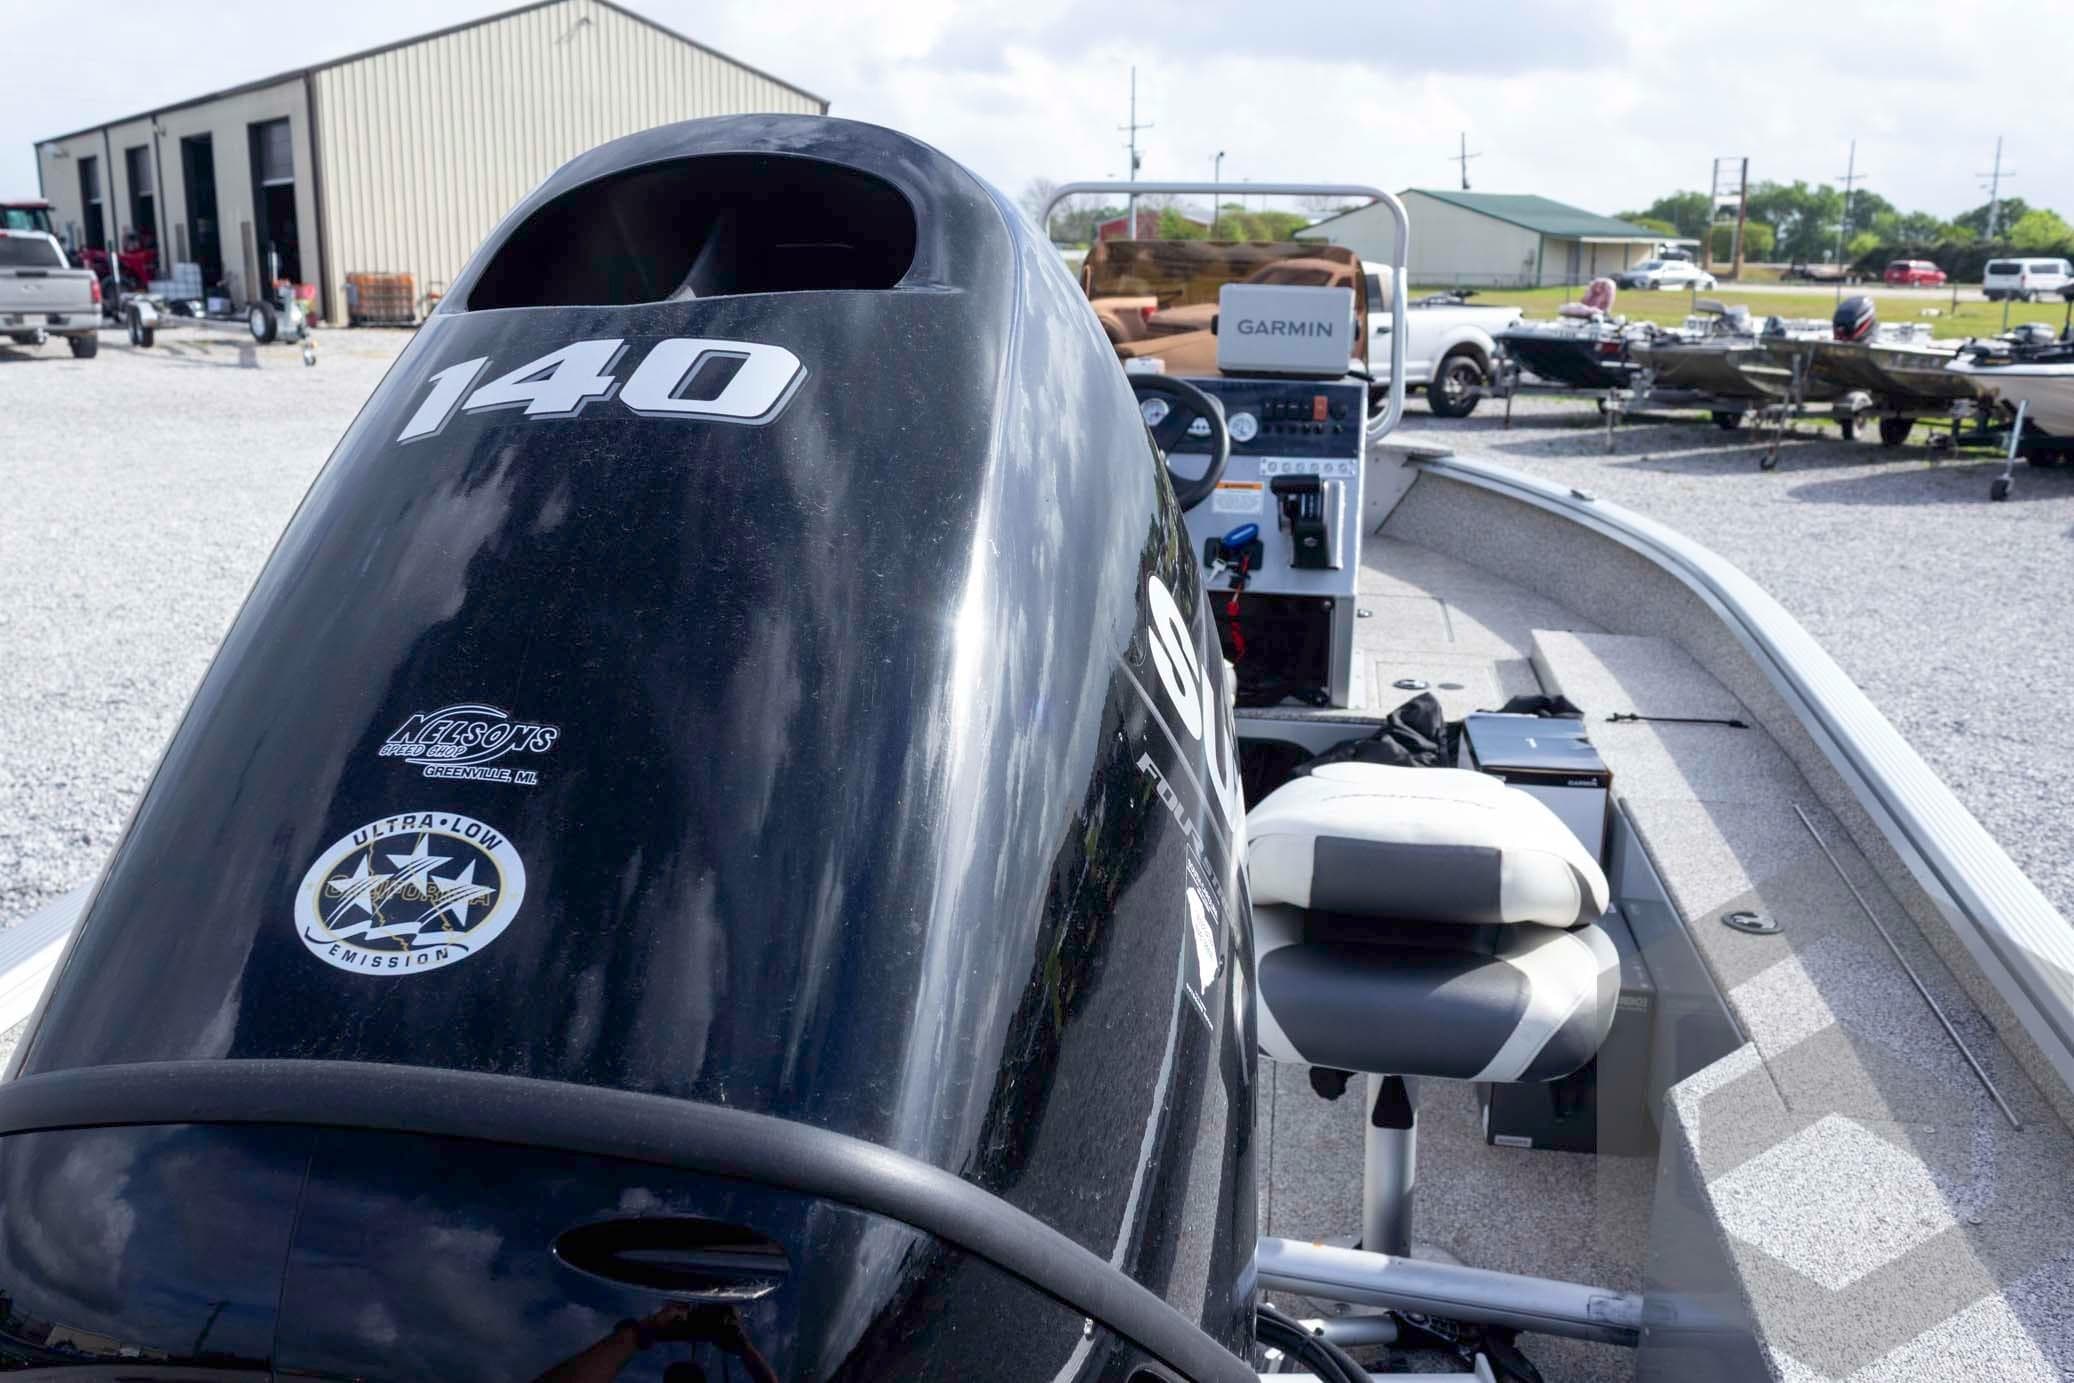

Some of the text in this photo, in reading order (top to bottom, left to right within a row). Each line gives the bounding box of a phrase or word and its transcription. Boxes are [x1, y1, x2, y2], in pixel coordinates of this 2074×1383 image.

[1237, 319, 1333, 337] GARMIN
[397, 338, 807, 446] 140
[386, 714, 559, 752] NELSONS
[378, 744, 468, 758] SPEED SHOP
[423, 765, 538, 785] GREENVILLE, MI.
[1136, 752, 1205, 857] FOUR
[328, 944, 450, 968] EMISSION
